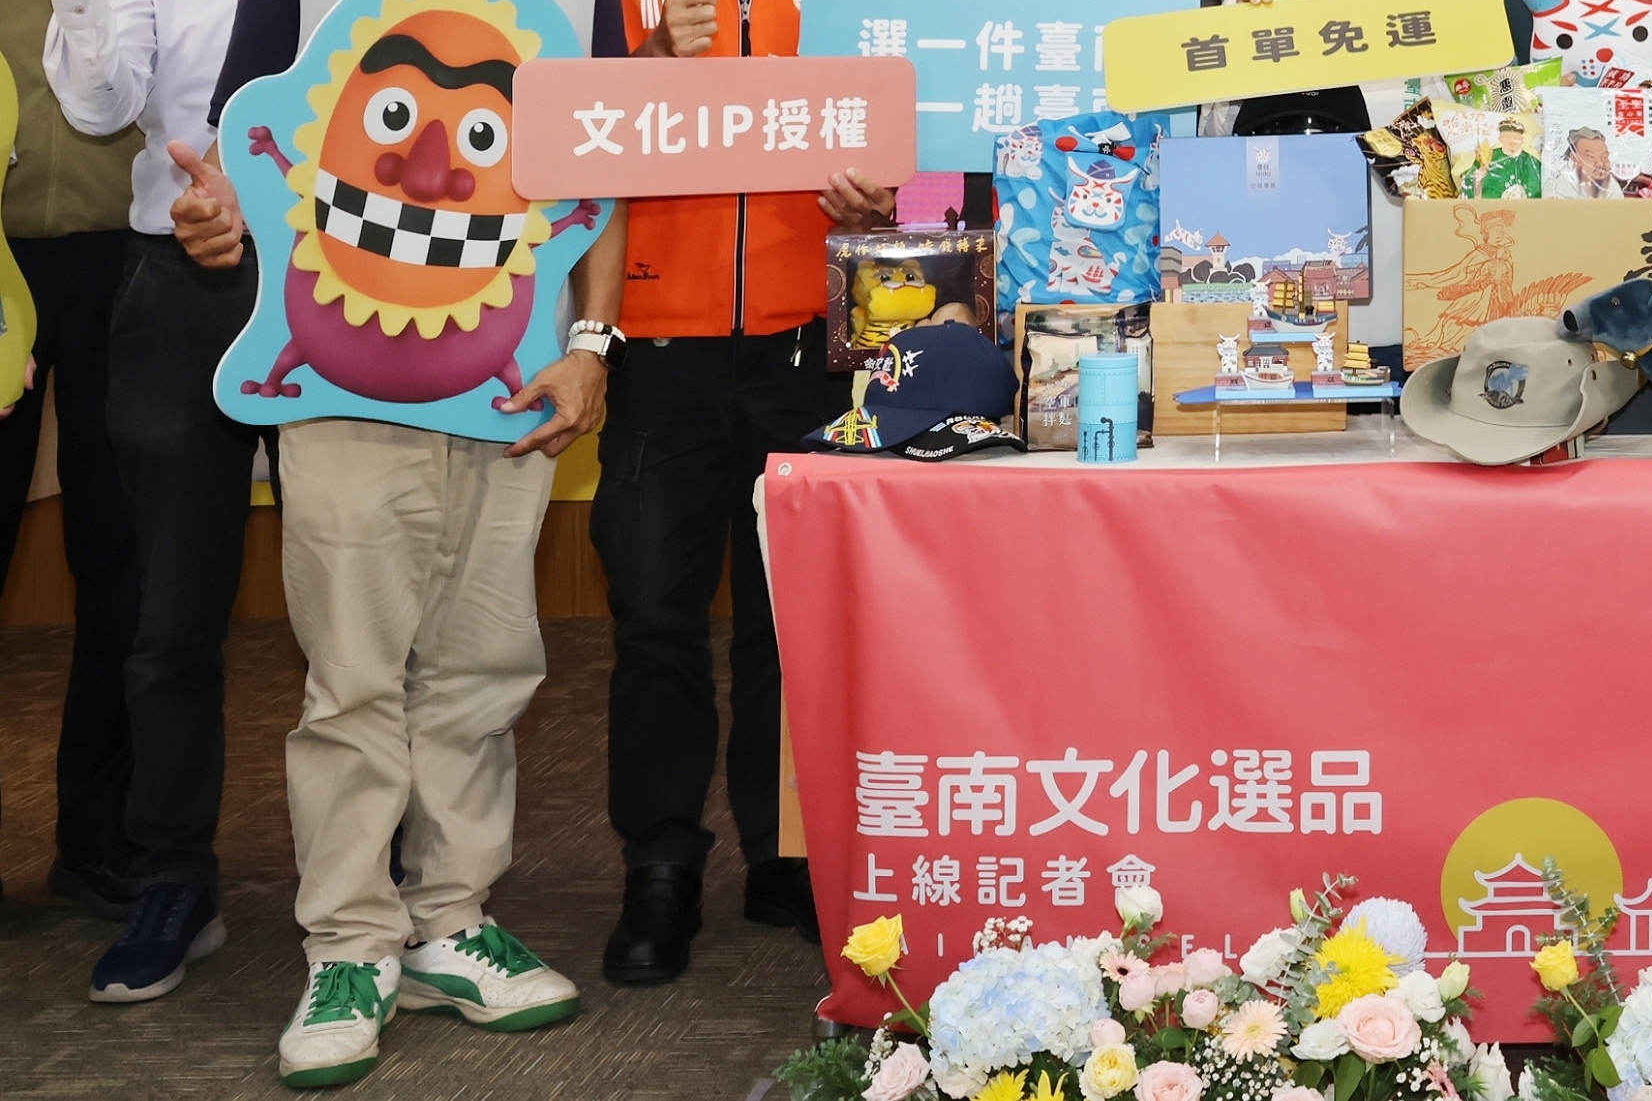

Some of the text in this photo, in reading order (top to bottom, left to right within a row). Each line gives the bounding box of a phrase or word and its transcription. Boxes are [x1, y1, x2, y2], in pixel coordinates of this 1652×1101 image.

[857, 18, 1106, 72] 選一件臺
[1180, 10, 1437, 73] 首單免運
[572, 97, 868, 156] 文化IP授權
[916, 83, 1107, 133] 一趟臺
[854, 747, 1384, 838] 臺南文化選品
[853, 852, 1156, 907] 上線記者會
